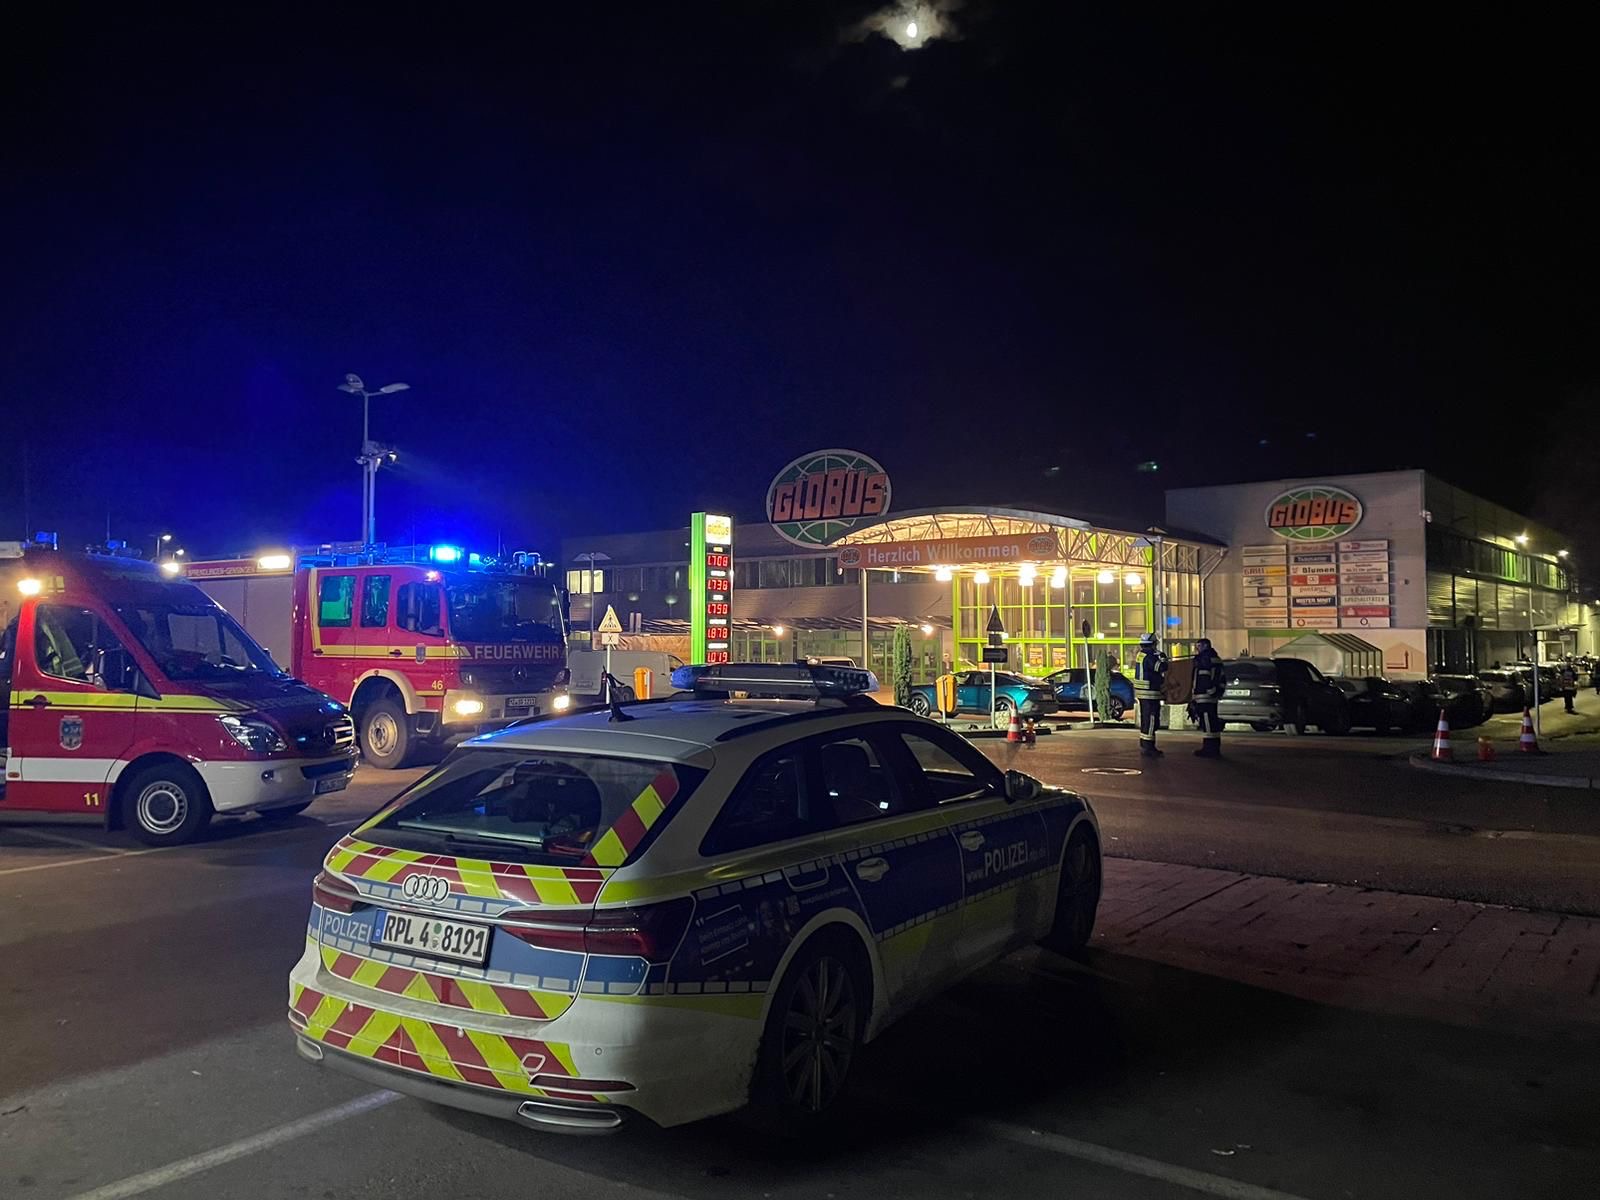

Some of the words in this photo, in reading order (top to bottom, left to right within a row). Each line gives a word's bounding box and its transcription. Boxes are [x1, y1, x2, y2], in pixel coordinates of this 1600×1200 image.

[772, 467, 888, 523] GLOBUS
[1270, 499, 1358, 527] GLOBUS
[867, 545, 921, 564] Herzlich
[926, 543, 1020, 562] Willkommen
[474, 645, 559, 660] FEUERWEHR
[431, 680, 443, 690] 46
[83, 792, 100, 806] 11
[323, 914, 372, 944] POLIZEI
[383, 915, 414, 945] RPL
[419, 921, 430, 948] 4
[441, 926, 486, 957] 8191
